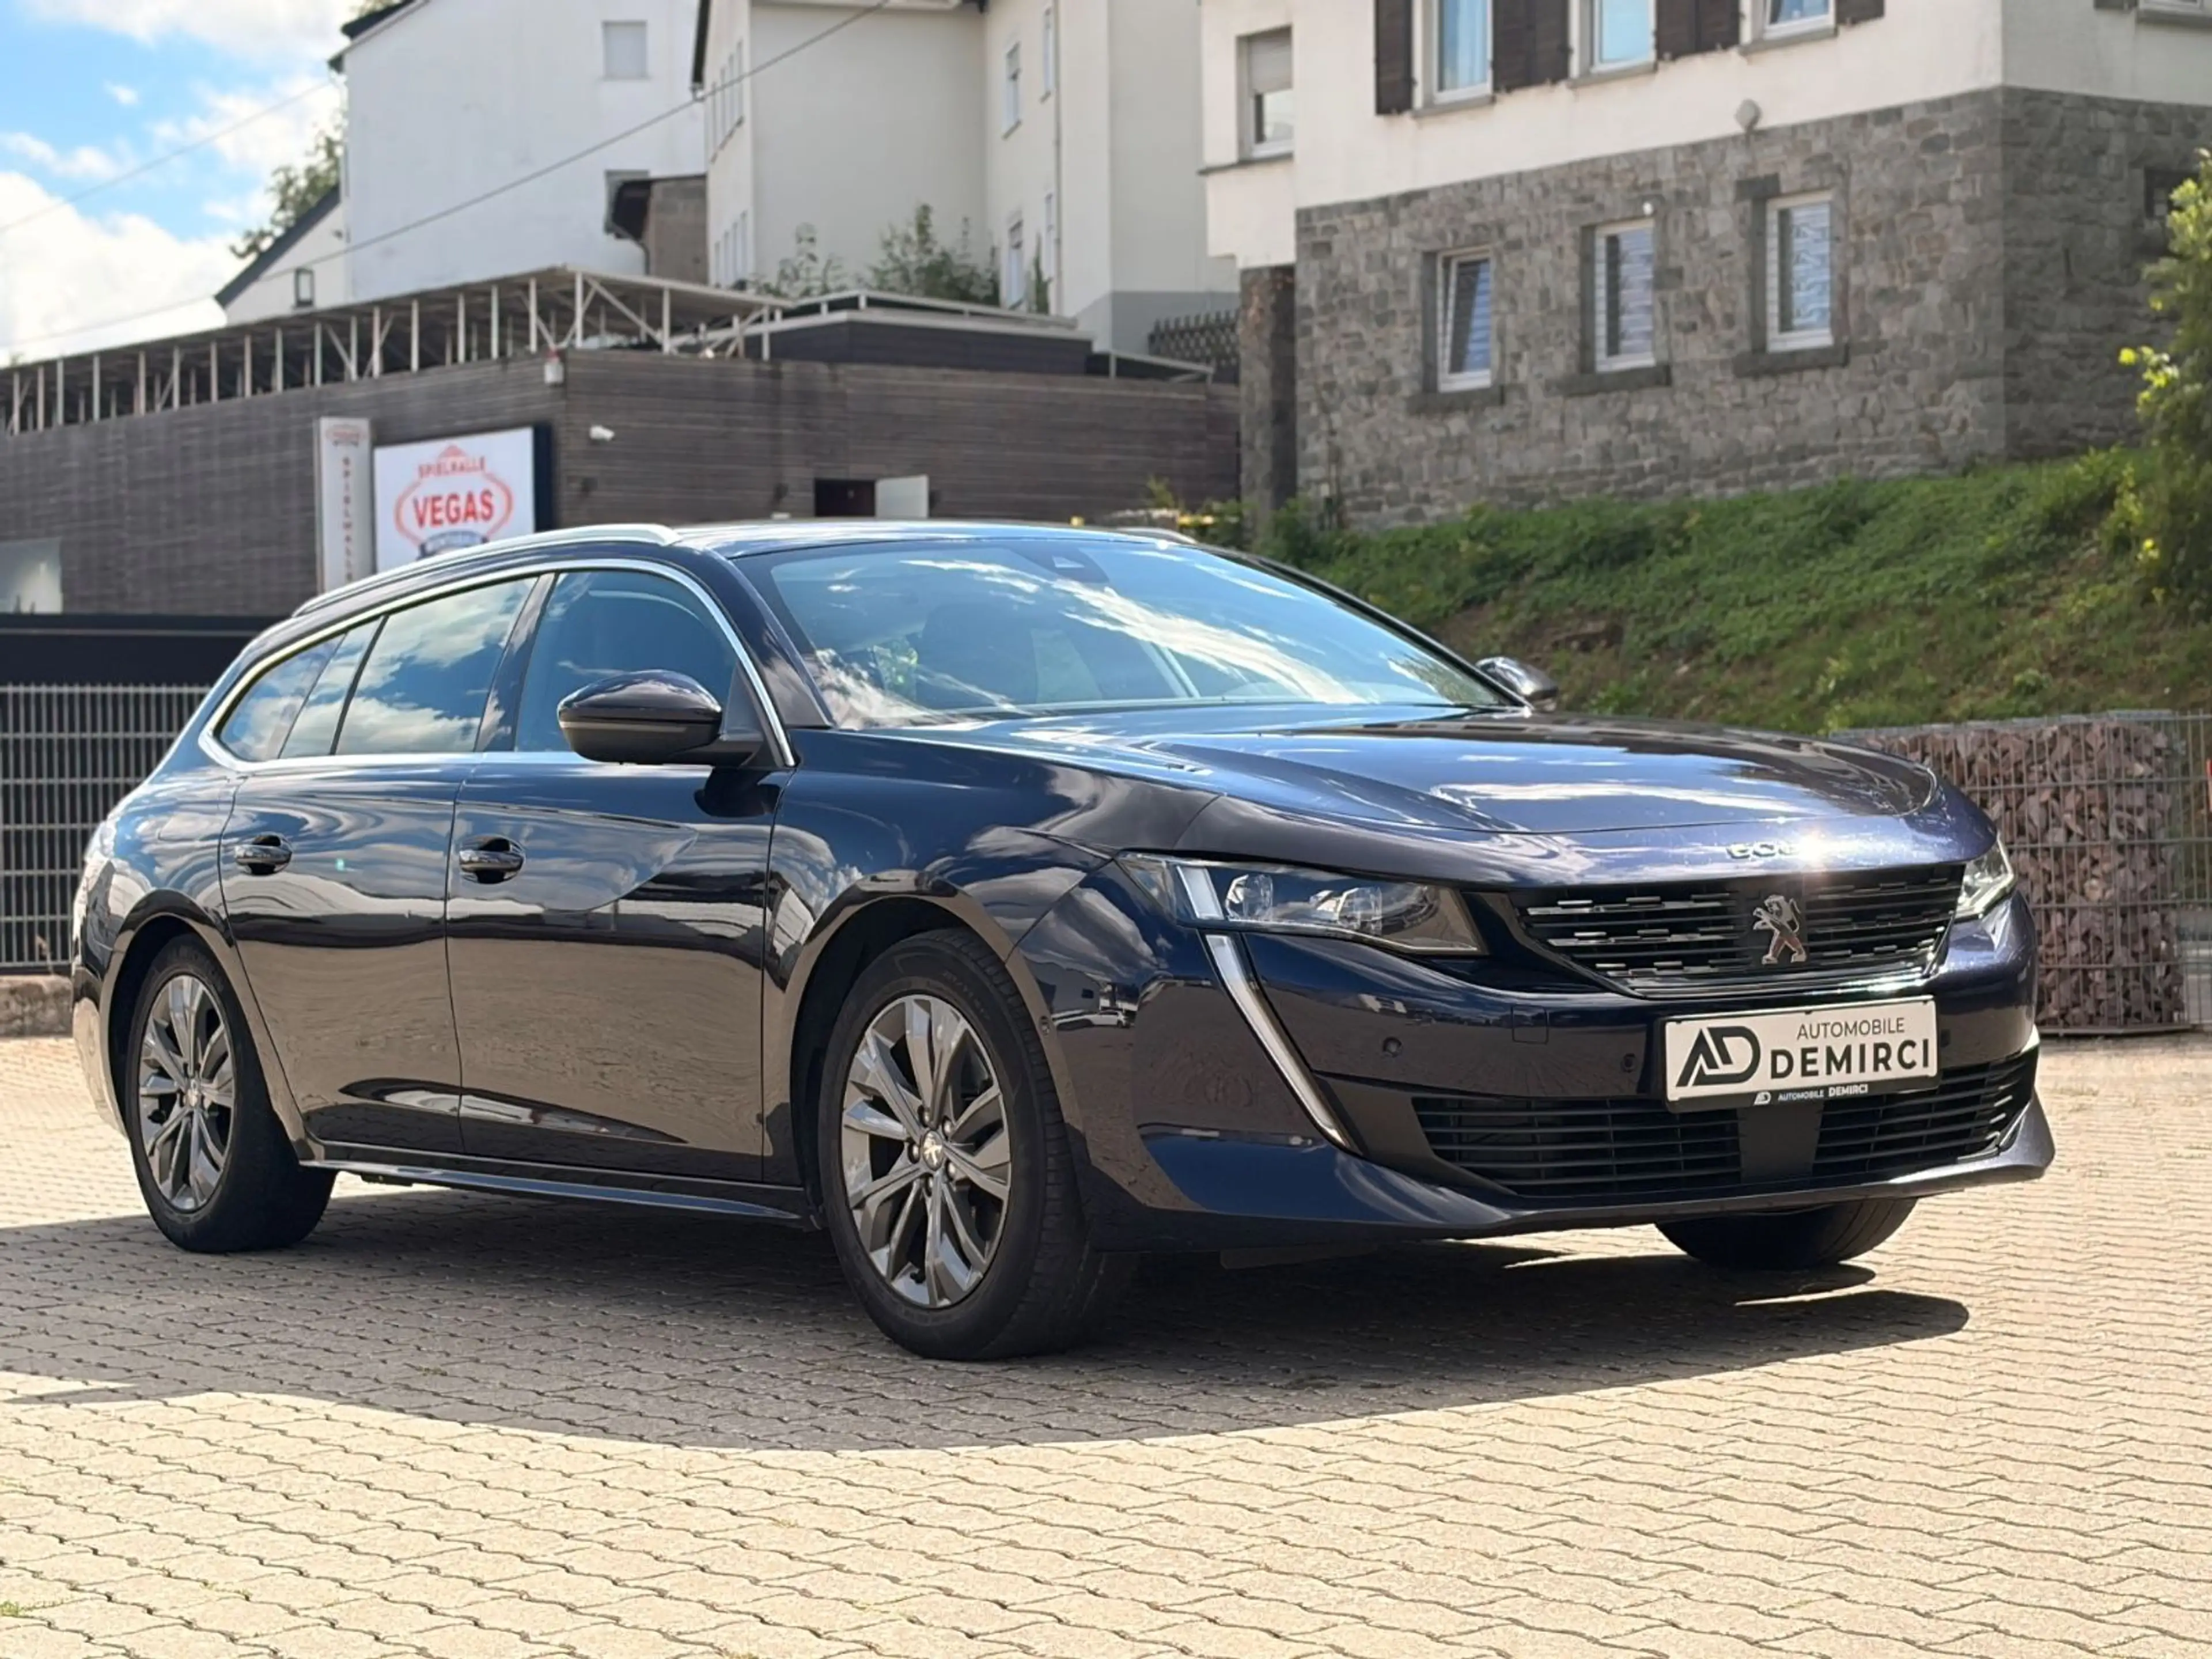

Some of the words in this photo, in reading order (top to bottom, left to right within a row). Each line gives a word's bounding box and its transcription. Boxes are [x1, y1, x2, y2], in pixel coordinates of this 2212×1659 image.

[413, 488, 494, 529] VEGAS
[1796, 1017, 1905, 1040] AUTOMOBILE
[1771, 1039, 1929, 1080] DEMIRCI
[1778, 1090, 1824, 1101] AUTOMOBILE
[1828, 1084, 1868, 1097] DEMIRCI
